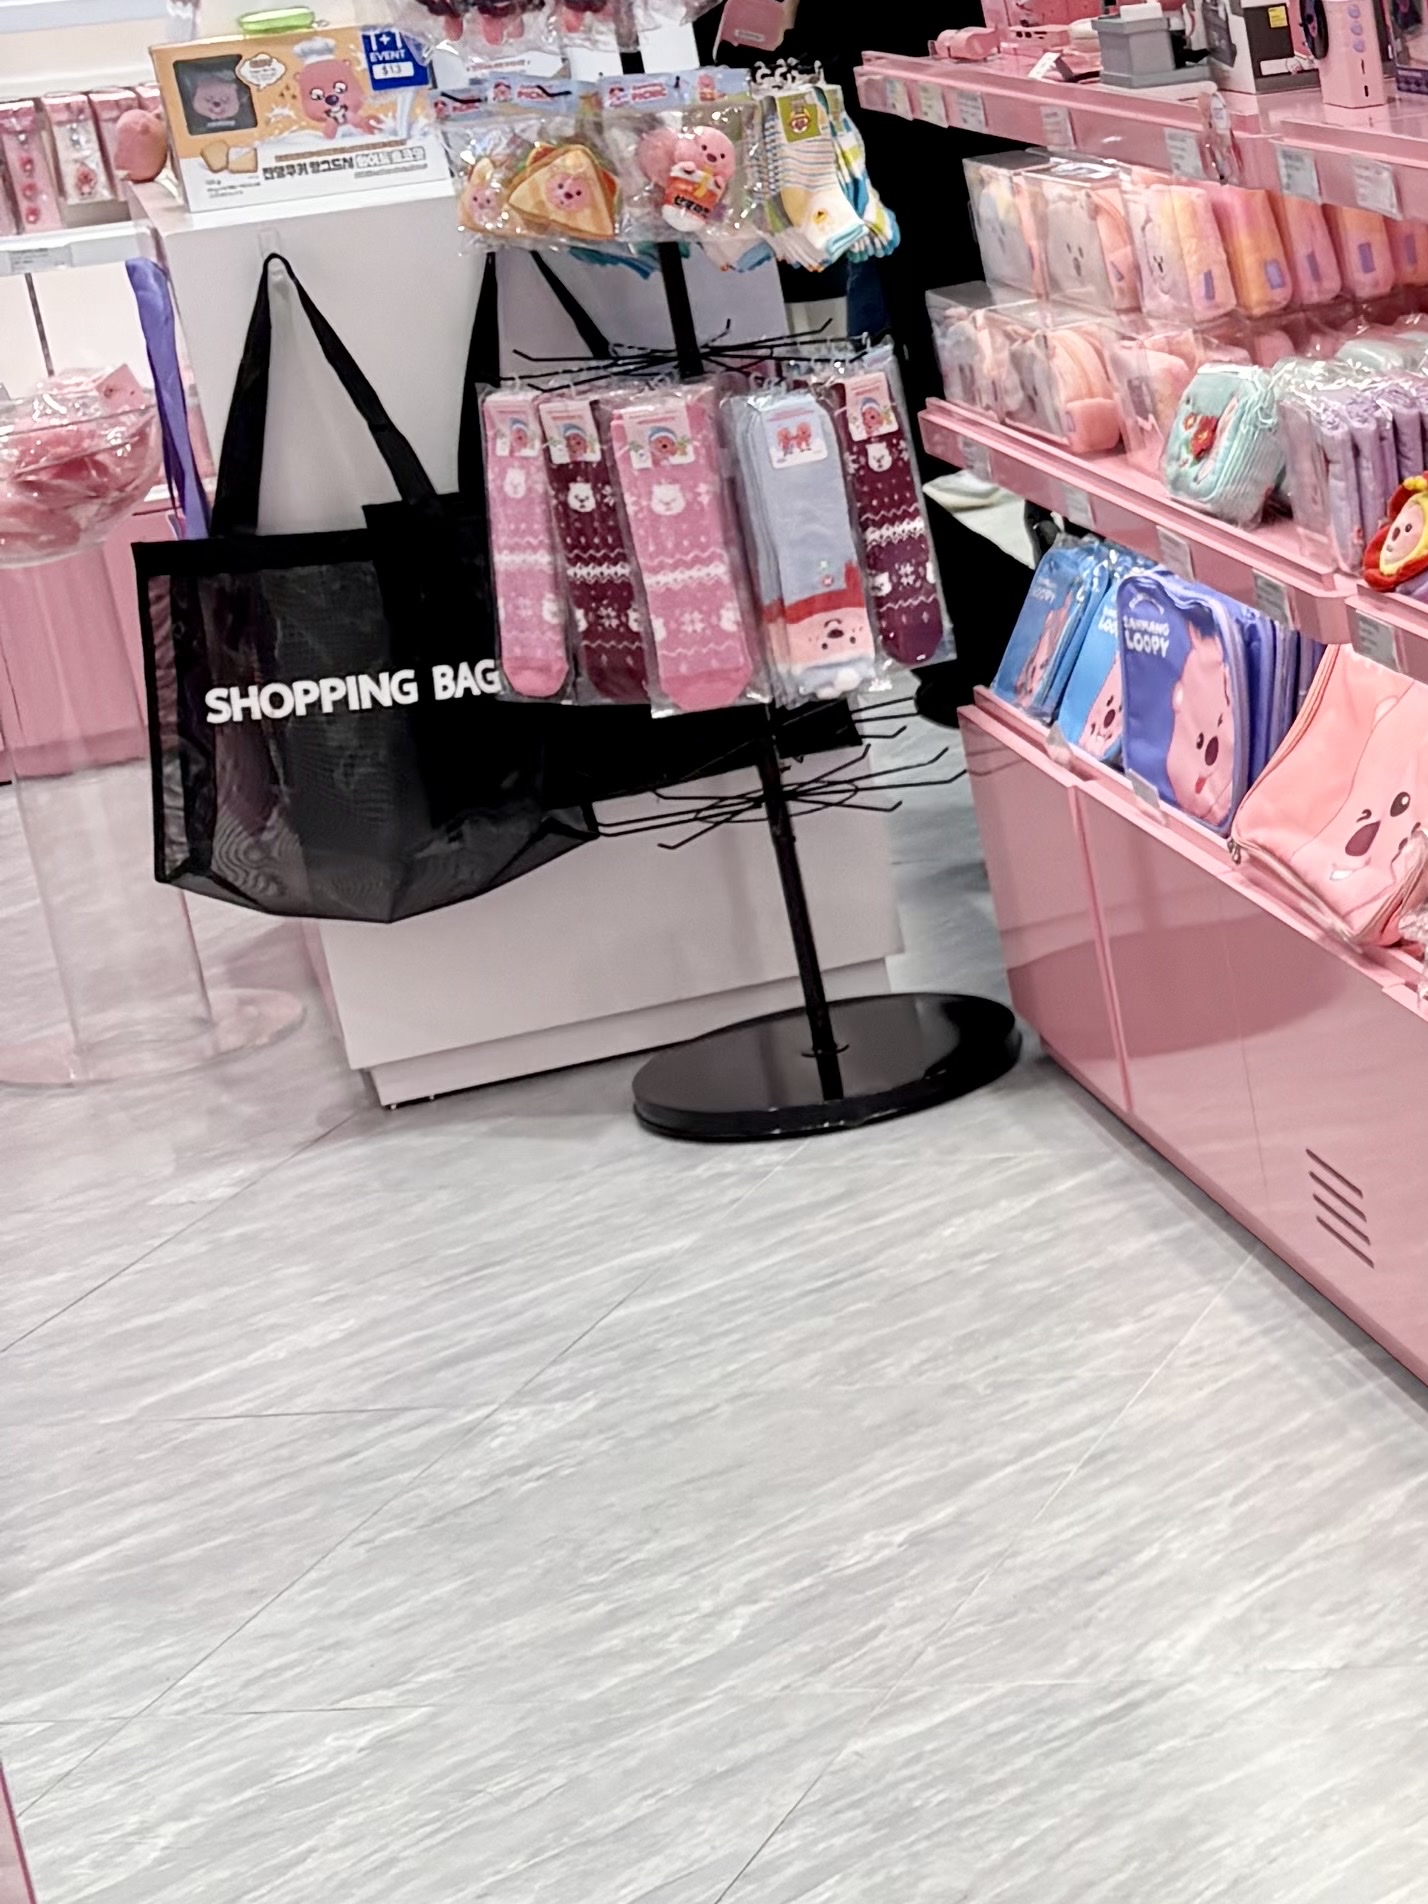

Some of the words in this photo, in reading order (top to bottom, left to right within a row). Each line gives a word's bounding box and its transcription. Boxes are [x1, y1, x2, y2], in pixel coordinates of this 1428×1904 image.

[1124, 629, 1170, 658] LOOPY
[204, 668, 419, 725] SHOPPING
[434, 658, 501, 703] BAG
